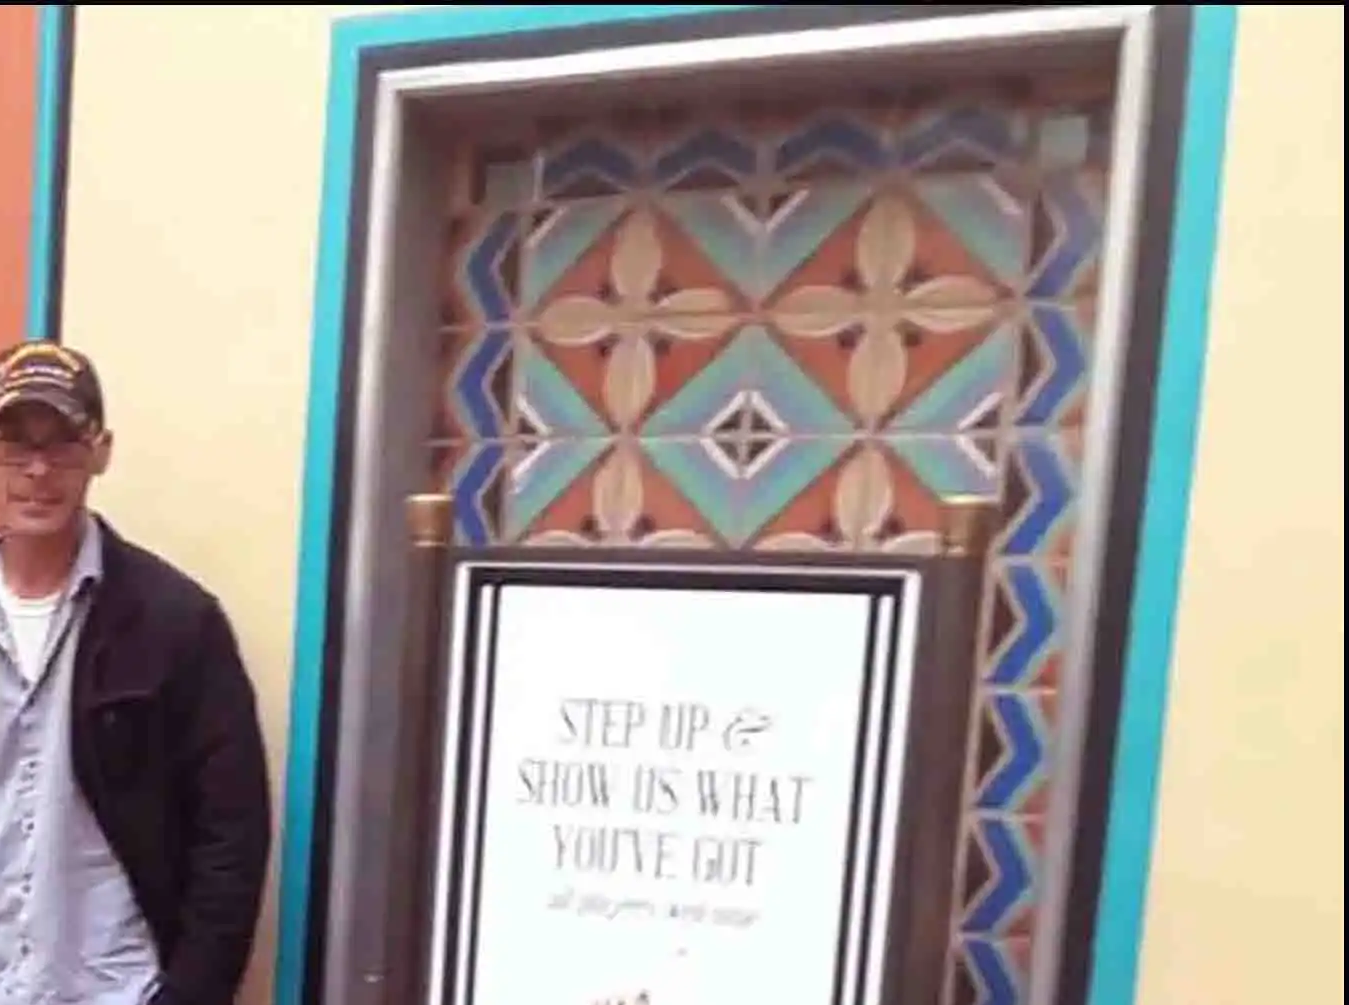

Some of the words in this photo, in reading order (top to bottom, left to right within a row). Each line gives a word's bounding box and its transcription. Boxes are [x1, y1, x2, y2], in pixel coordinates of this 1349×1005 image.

[559, 697, 646, 749] STEP
[659, 701, 711, 751] UP
[722, 705, 773, 751] &
[516, 756, 614, 809] SHOW
[632, 763, 685, 815] US
[696, 768, 815, 825] WHAT
[692, 835, 766, 887] GOT
